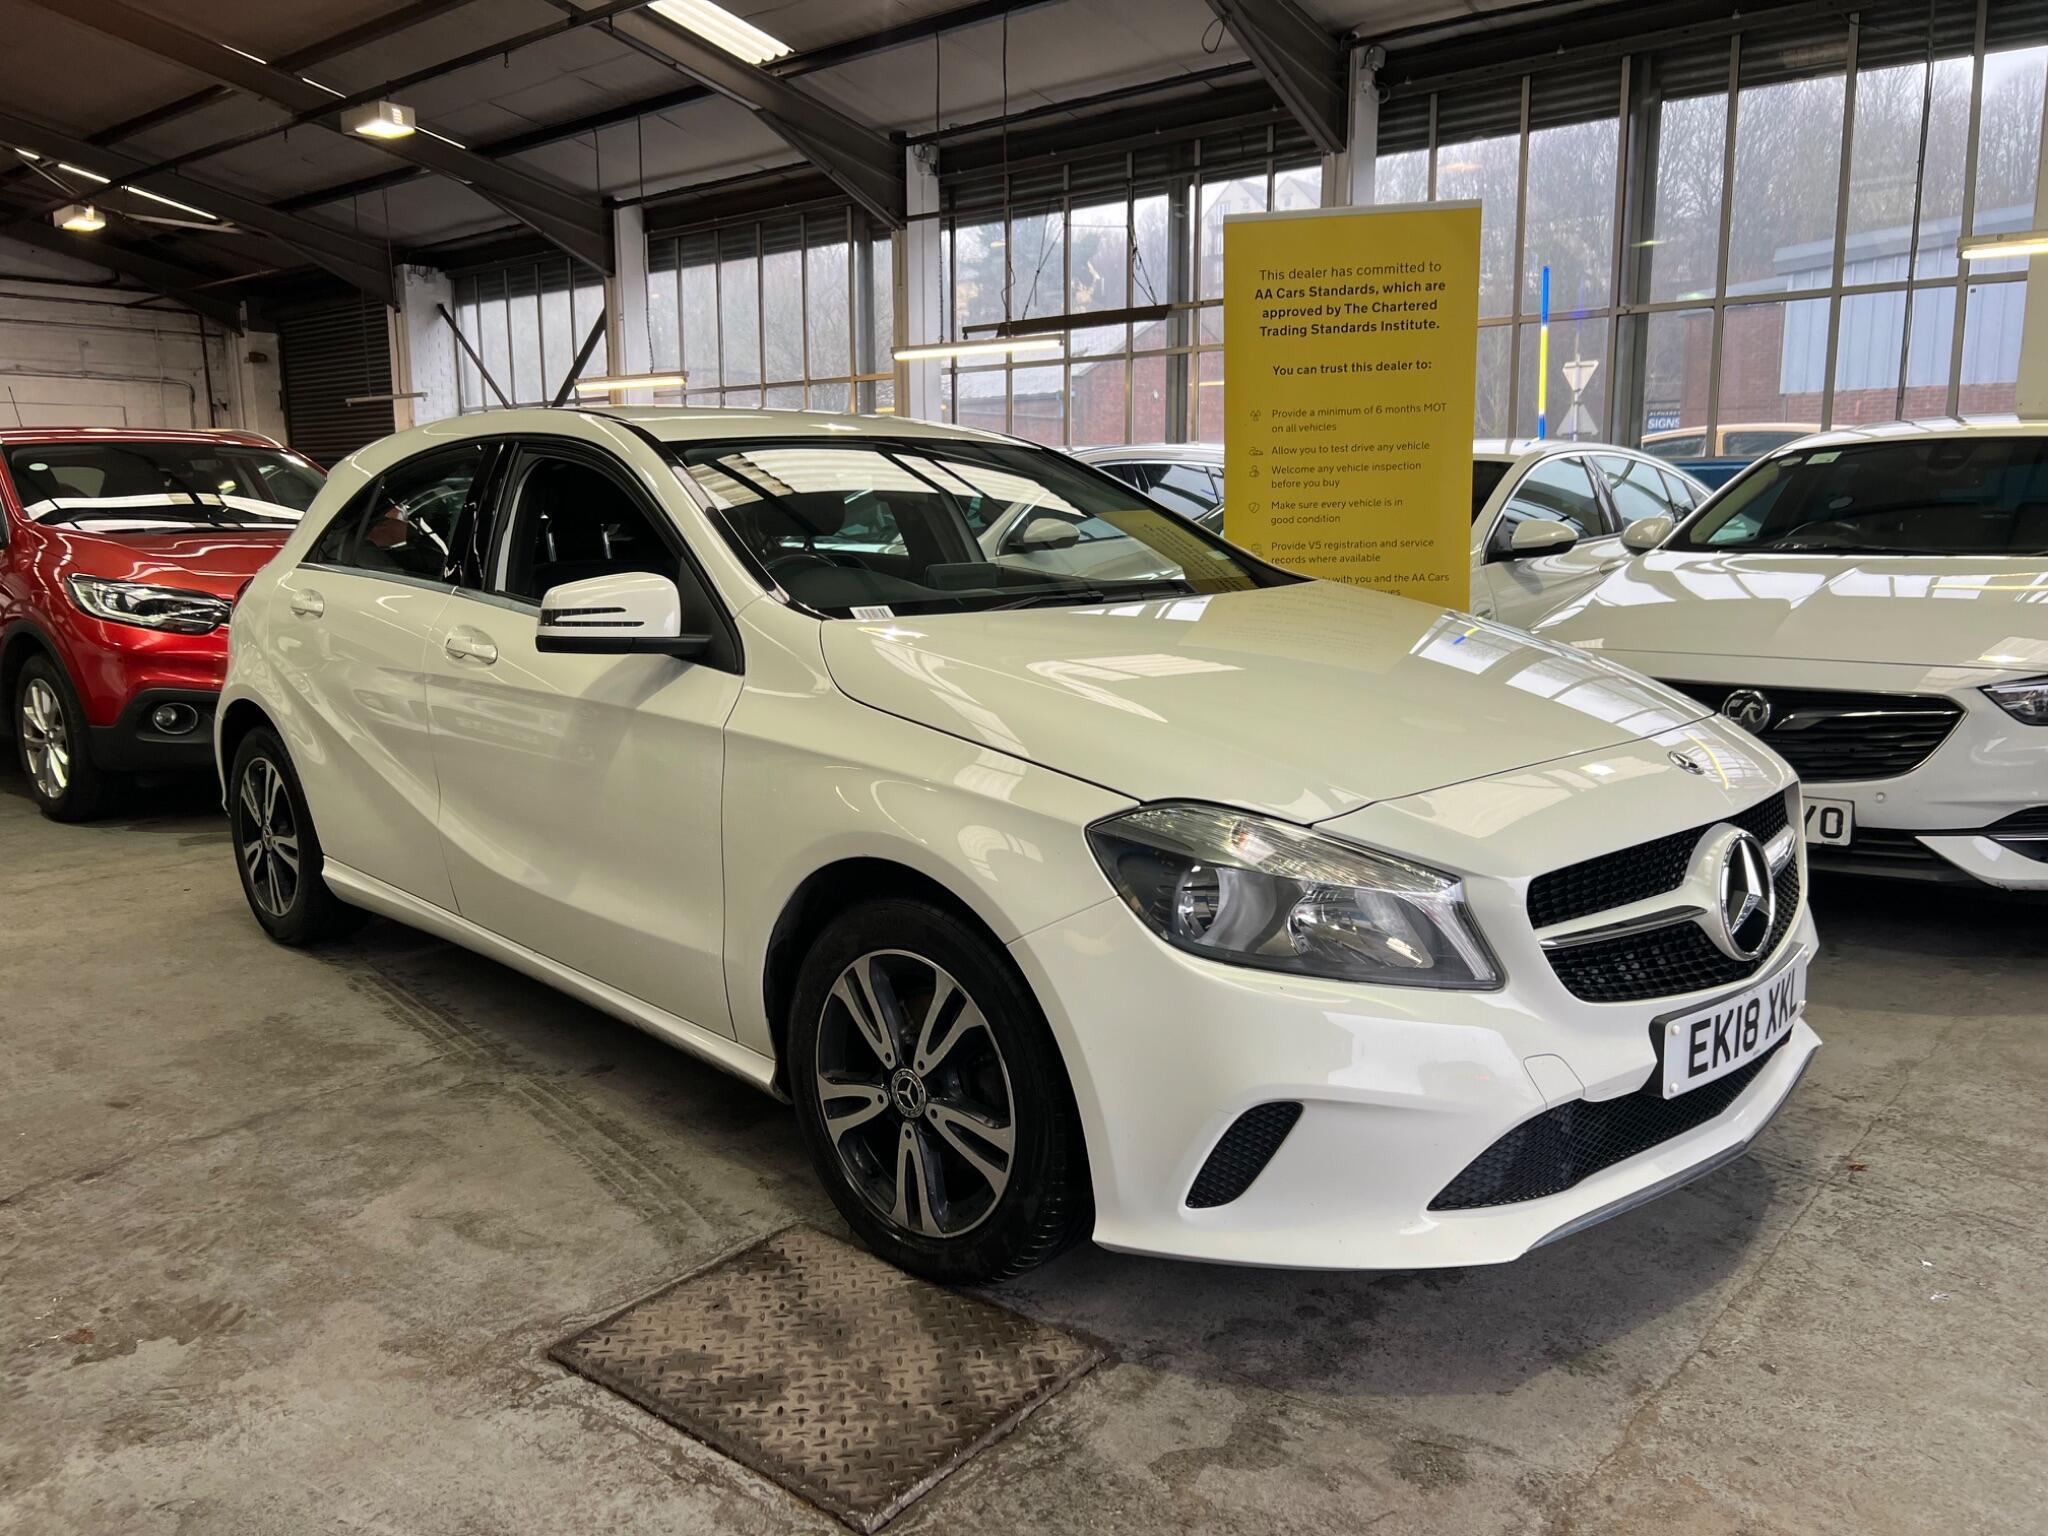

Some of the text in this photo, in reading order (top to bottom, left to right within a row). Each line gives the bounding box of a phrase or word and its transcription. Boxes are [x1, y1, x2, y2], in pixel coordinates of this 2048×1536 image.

[1259, 262, 1441, 280] This dealer has committed to
[1255, 282, 1446, 300] AA Cars Standards, which are
[1262, 300, 1437, 319] approved by The Chartered
[1260, 319, 1439, 337] Trading Standards Institute.
[1273, 360, 1431, 376] You can trust this dealer to:
[1272, 409, 1307, 418] Provide
[1317, 407, 1361, 416] minimum
[1364, 405, 1373, 414] of
[1376, 405, 1382, 414] 6
[1385, 404, 1421, 414] months
[1424, 403, 1447, 413] MOT
[1286, 424, 1296, 432] all
[1299, 423, 1336, 432] vehicles
[1272, 441, 1430, 456] Allow you to test drive any vehicle
[1272, 461, 1421, 475] Welcome any vehicle inspection
[1272, 478, 1340, 489] before you buy
[1271, 501, 1296, 510] Make
[1321, 501, 1346, 510] every
[1349, 498, 1381, 508] vehicle
[1384, 498, 1392, 506] is
[1394, 498, 1403, 506] in
[1271, 515, 1340, 525] good condition
[1271, 539, 1434, 551] Provide V5 registration and service
[1271, 554, 1380, 564] records where available
[1332, 575, 1352, 583] with
[1354, 576, 1372, 585] you
[1374, 574, 1392, 583] and
[1394, 573, 1409, 582] the
[1411, 574, 1425, 582] AA
[1428, 573, 1450, 582] Cars
[1688, 967, 1797, 1079] EK18 XKL
